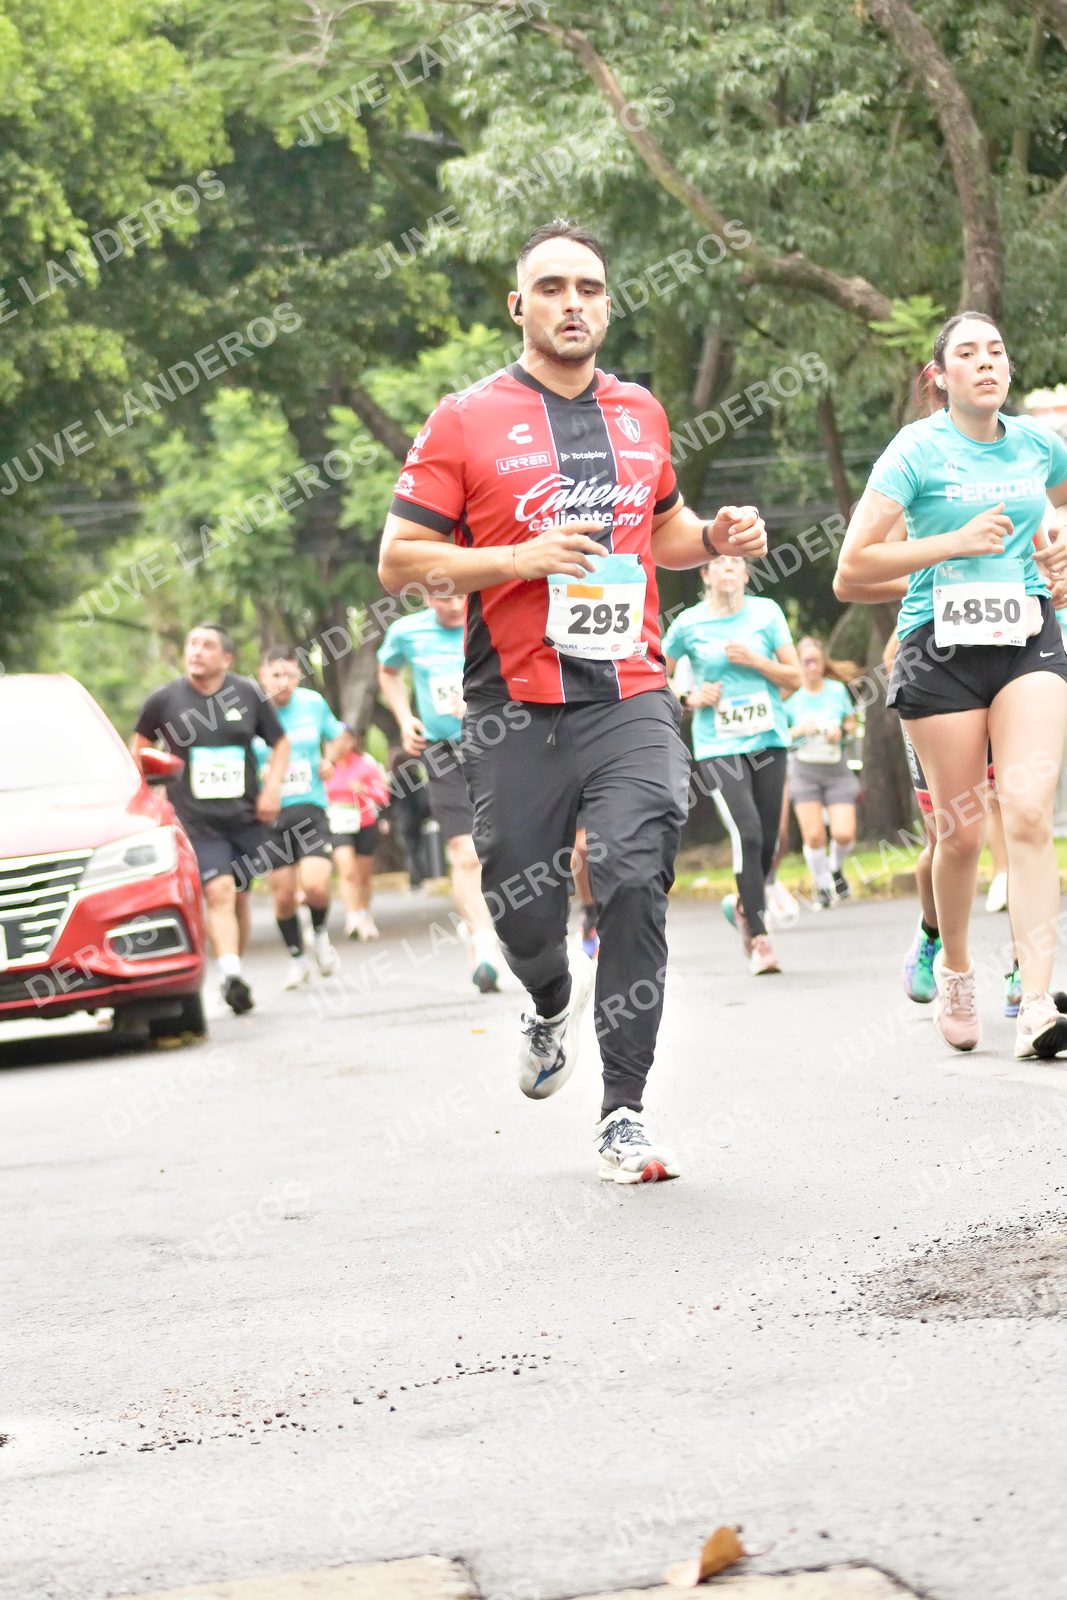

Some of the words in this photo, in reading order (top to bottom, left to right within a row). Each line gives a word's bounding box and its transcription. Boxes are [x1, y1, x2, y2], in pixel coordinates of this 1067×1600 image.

[499, 454, 549, 471] URREA
[571, 450, 608, 461] Totalplay
[513, 472, 651, 522] Caliente
[568, 603, 631, 636] 293
[942, 598, 1021, 626] 4850
[718, 703, 768, 726] 3478
